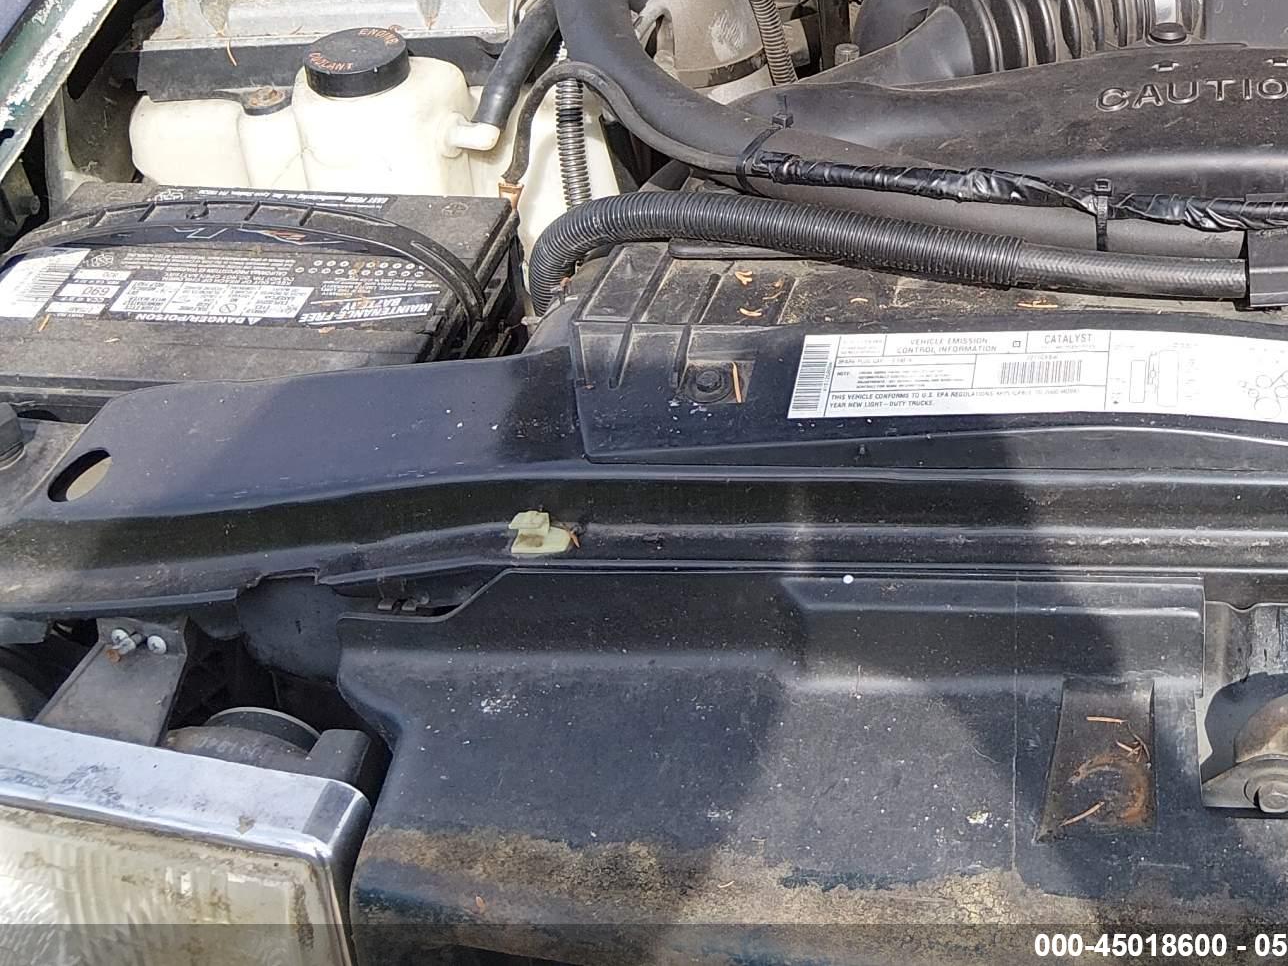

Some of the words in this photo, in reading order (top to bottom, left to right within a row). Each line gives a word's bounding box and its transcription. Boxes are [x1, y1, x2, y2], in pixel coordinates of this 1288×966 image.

[300, 302, 433, 323] MAINTENANCE-FREE
[135, 314, 246, 323] DANGER/POISON
[910, 337, 945, 345] VEHICLE
[947, 336, 988, 344] EMISSION
[1044, 333, 1093, 345] CATALYST
[938, 345, 997, 353] INFORMATION
